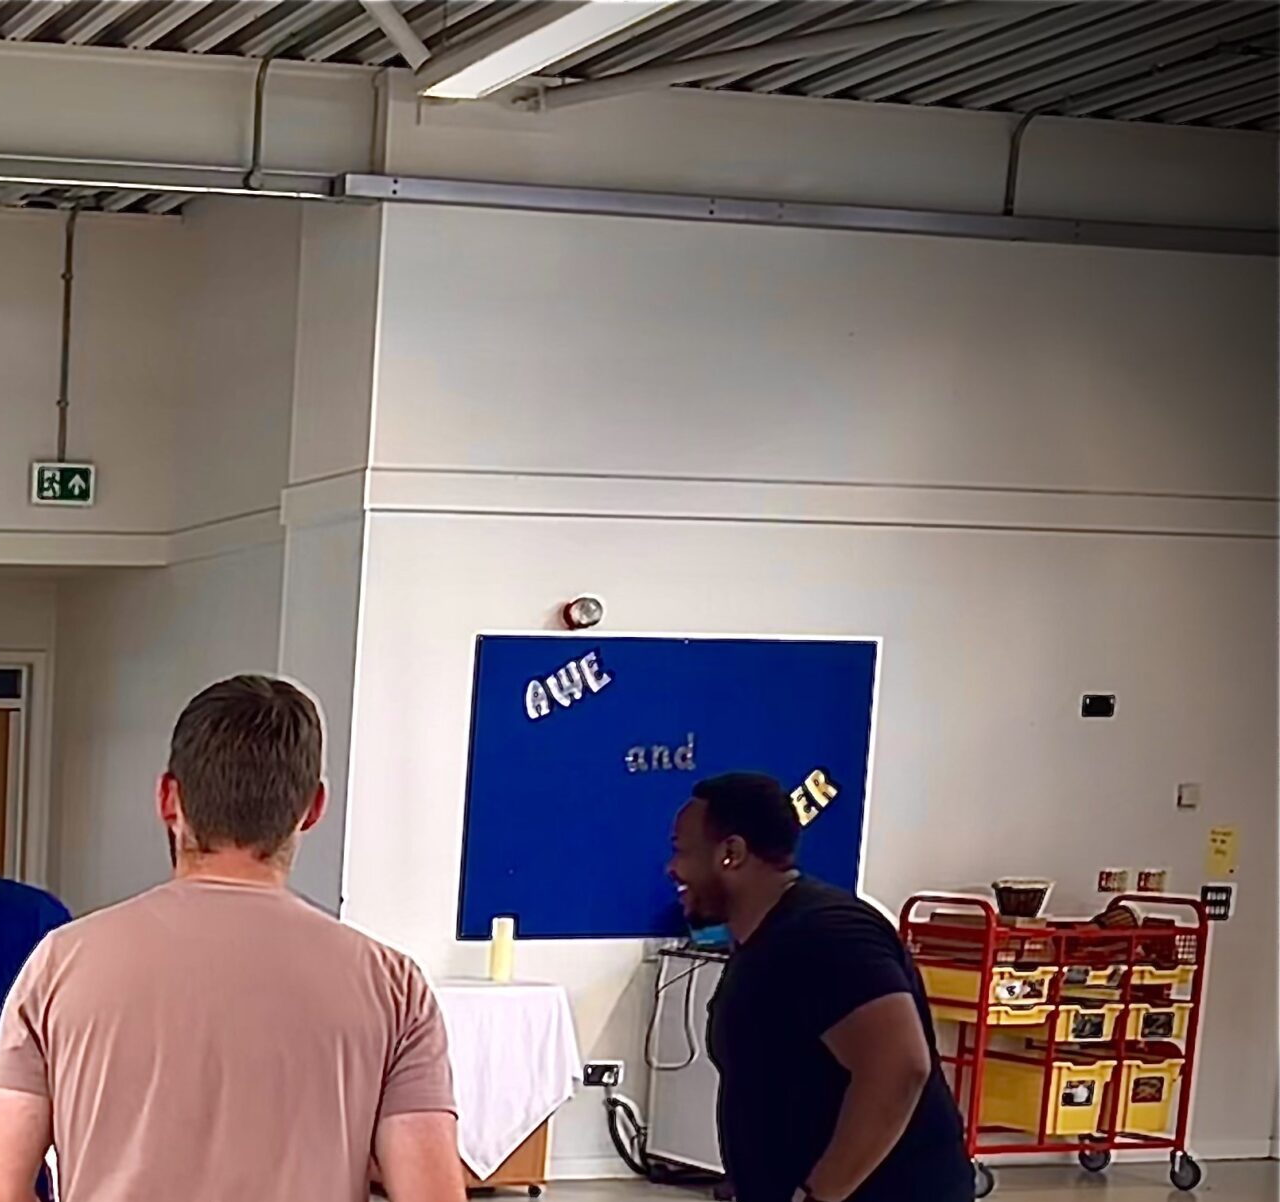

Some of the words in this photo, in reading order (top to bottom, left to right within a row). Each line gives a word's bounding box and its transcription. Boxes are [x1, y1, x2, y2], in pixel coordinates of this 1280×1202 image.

[525, 650, 612, 719] AWE
[625, 732, 696, 772] and
[789, 769, 838, 827] ER
